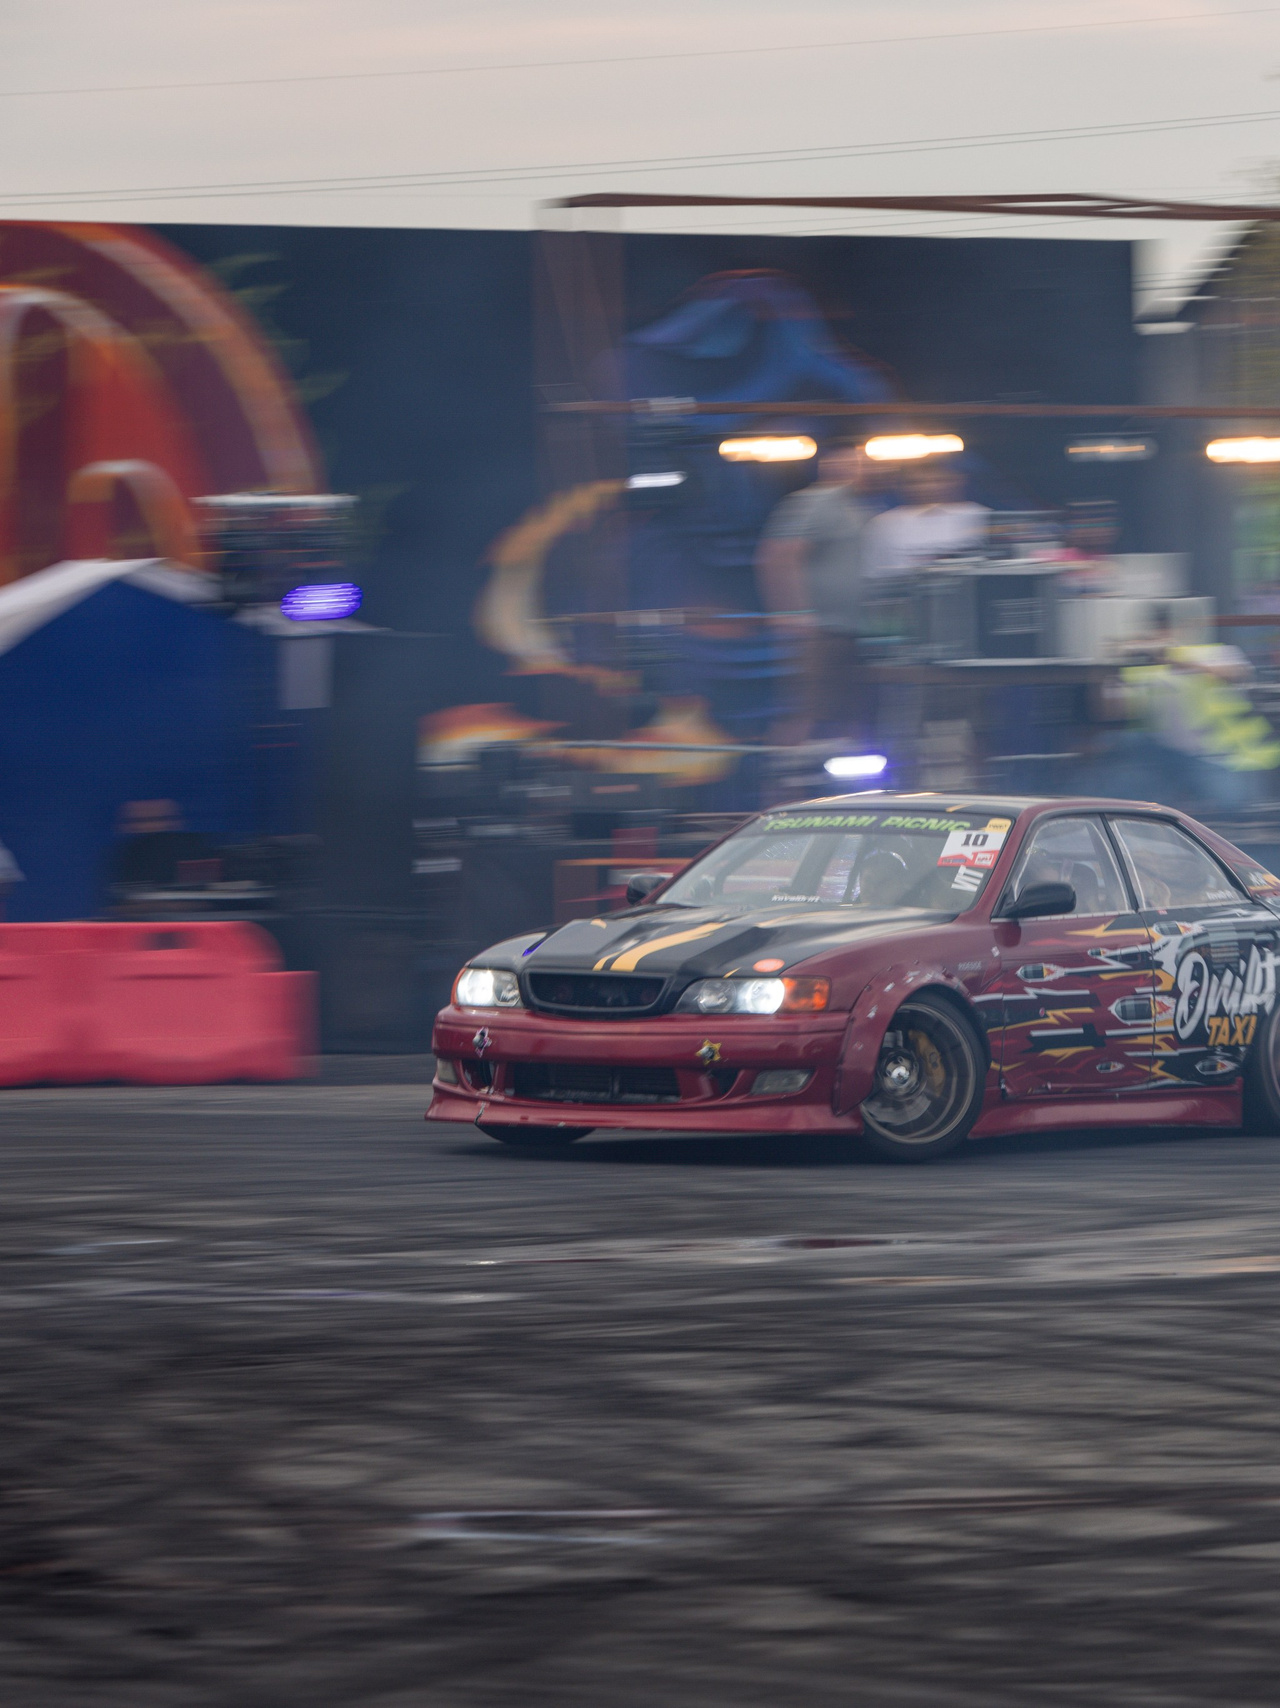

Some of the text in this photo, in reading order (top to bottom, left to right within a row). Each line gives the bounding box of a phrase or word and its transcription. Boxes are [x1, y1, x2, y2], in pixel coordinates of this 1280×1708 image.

[765, 815, 877, 831] TSUNAMI
[881, 815, 971, 831] PICNIC
[961, 833, 989, 847] 10
[1208, 1014, 1258, 1046] TAXI
